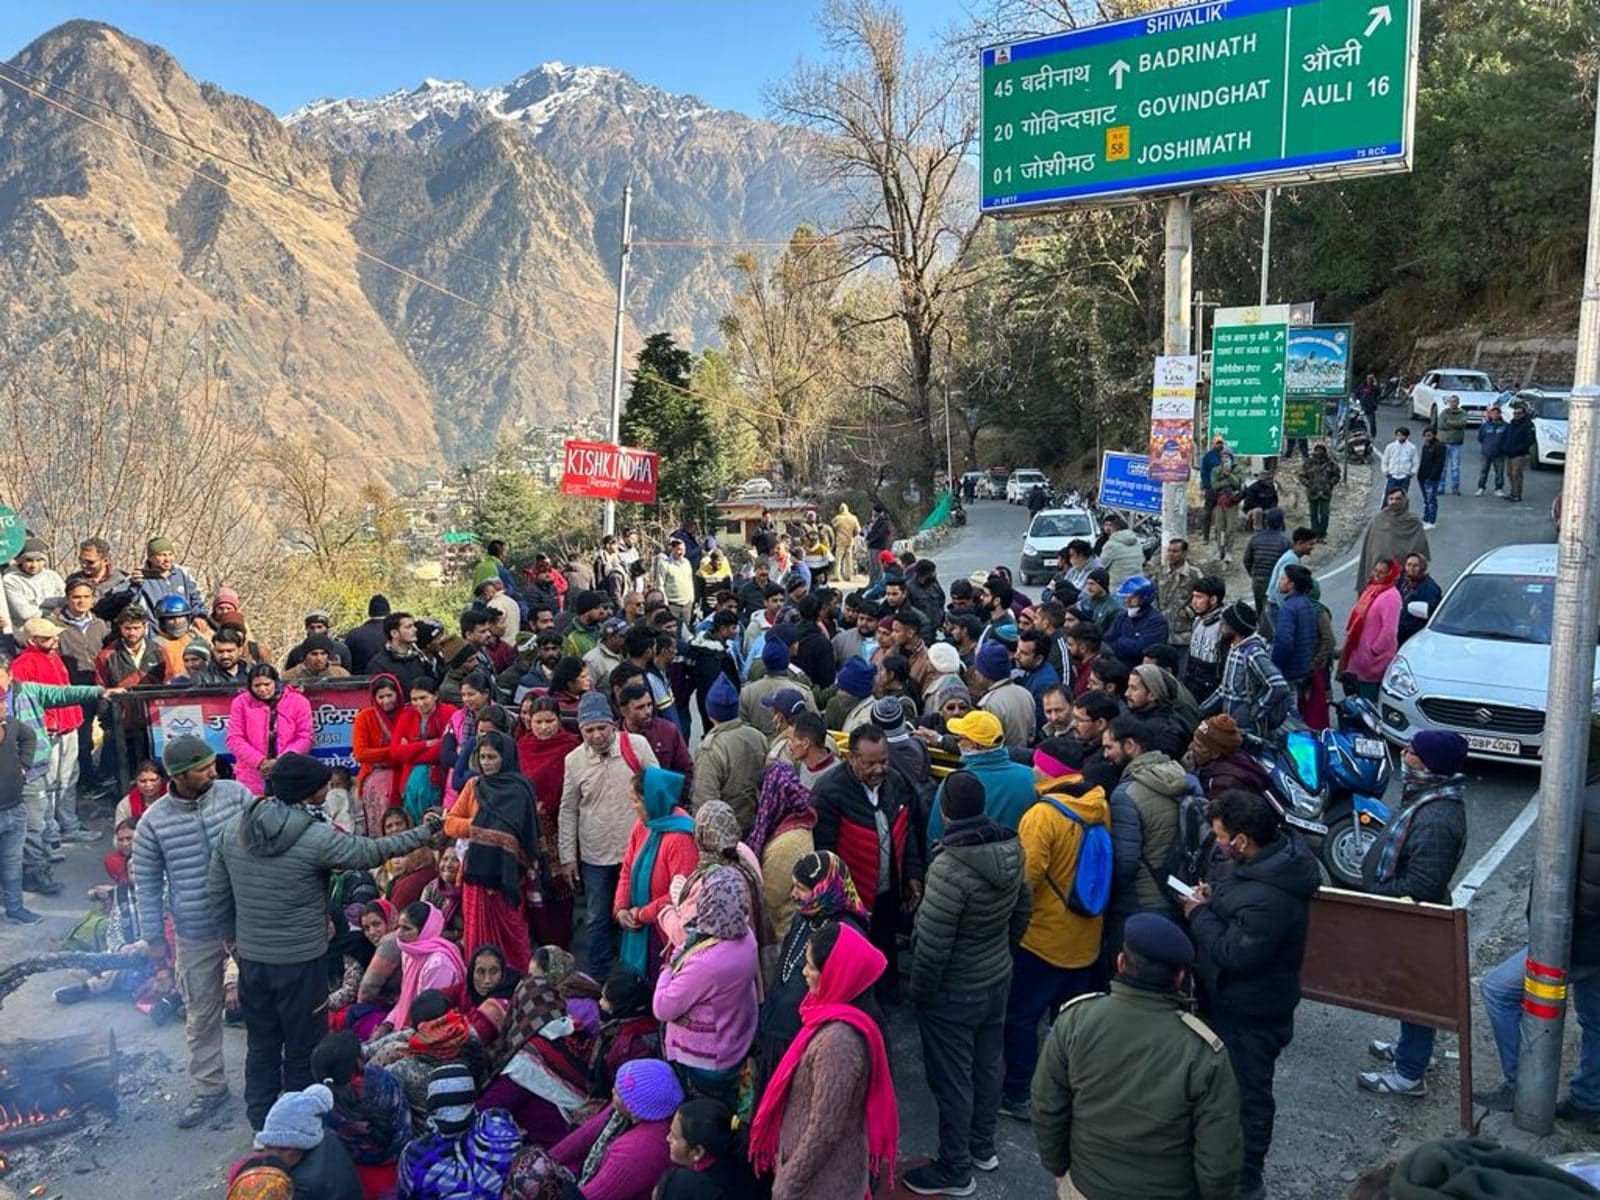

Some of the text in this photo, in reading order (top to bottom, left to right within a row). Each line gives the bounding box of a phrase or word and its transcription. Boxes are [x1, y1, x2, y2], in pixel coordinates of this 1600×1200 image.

[1146, 4, 1222, 34] SHIVALIK
[1139, 33, 1257, 73] BADRINATH
[1302, 38, 1363, 72] औली
[994, 64, 1091, 97] 45 बद्रीनाथ
[1301, 75, 1390, 108] AULI 16
[1137, 79, 1270, 118] GOVINDGHAT
[994, 105, 1117, 142] 20 गोविन्दघाट
[1111, 143, 1124, 155] 58
[1137, 131, 1251, 165] JOSHIMATH
[1368, 146, 1387, 156] RCC
[993, 151, 1096, 184] 01 जोशीमठ
[567, 448, 652, 484] KISHKINDHA
